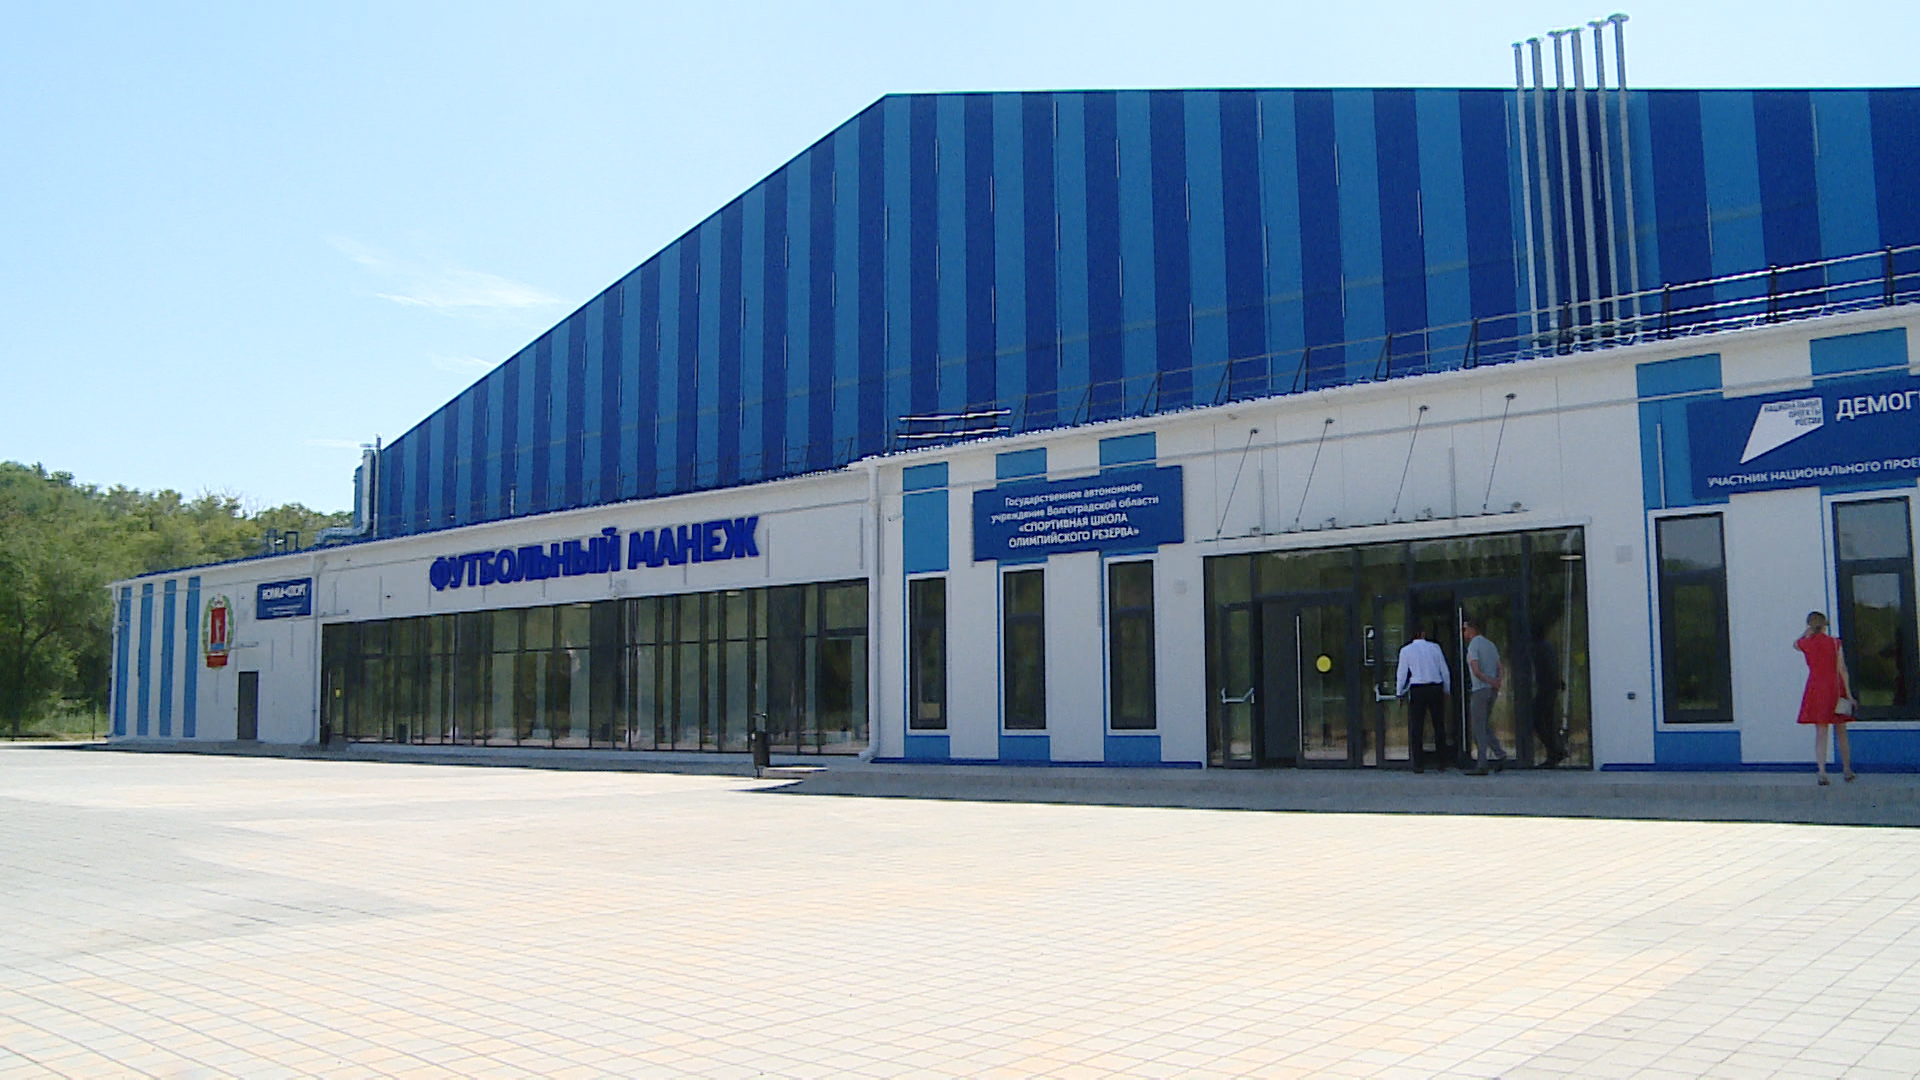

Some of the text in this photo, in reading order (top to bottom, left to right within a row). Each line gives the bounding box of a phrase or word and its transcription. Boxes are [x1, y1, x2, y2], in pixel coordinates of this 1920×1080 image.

[1836, 390, 1920, 422] ДЕМОГ
[1707, 456, 1920, 488] УЧАСТНИК НАЦИОНАЛЬНОГО ПРОЕ
[991, 495, 1159, 525] учреждение Волгоградской области
[1005, 483, 1143, 507] Государственное автономное
[1019, 512, 1129, 532] «СПОРТИВНАЯ ШКОЛА
[429, 515, 760, 592] ФУТБОЛЬНЫЙ МАНЕЖ
[1009, 530, 1091, 548] ОЛИМПИЙСКОГО
